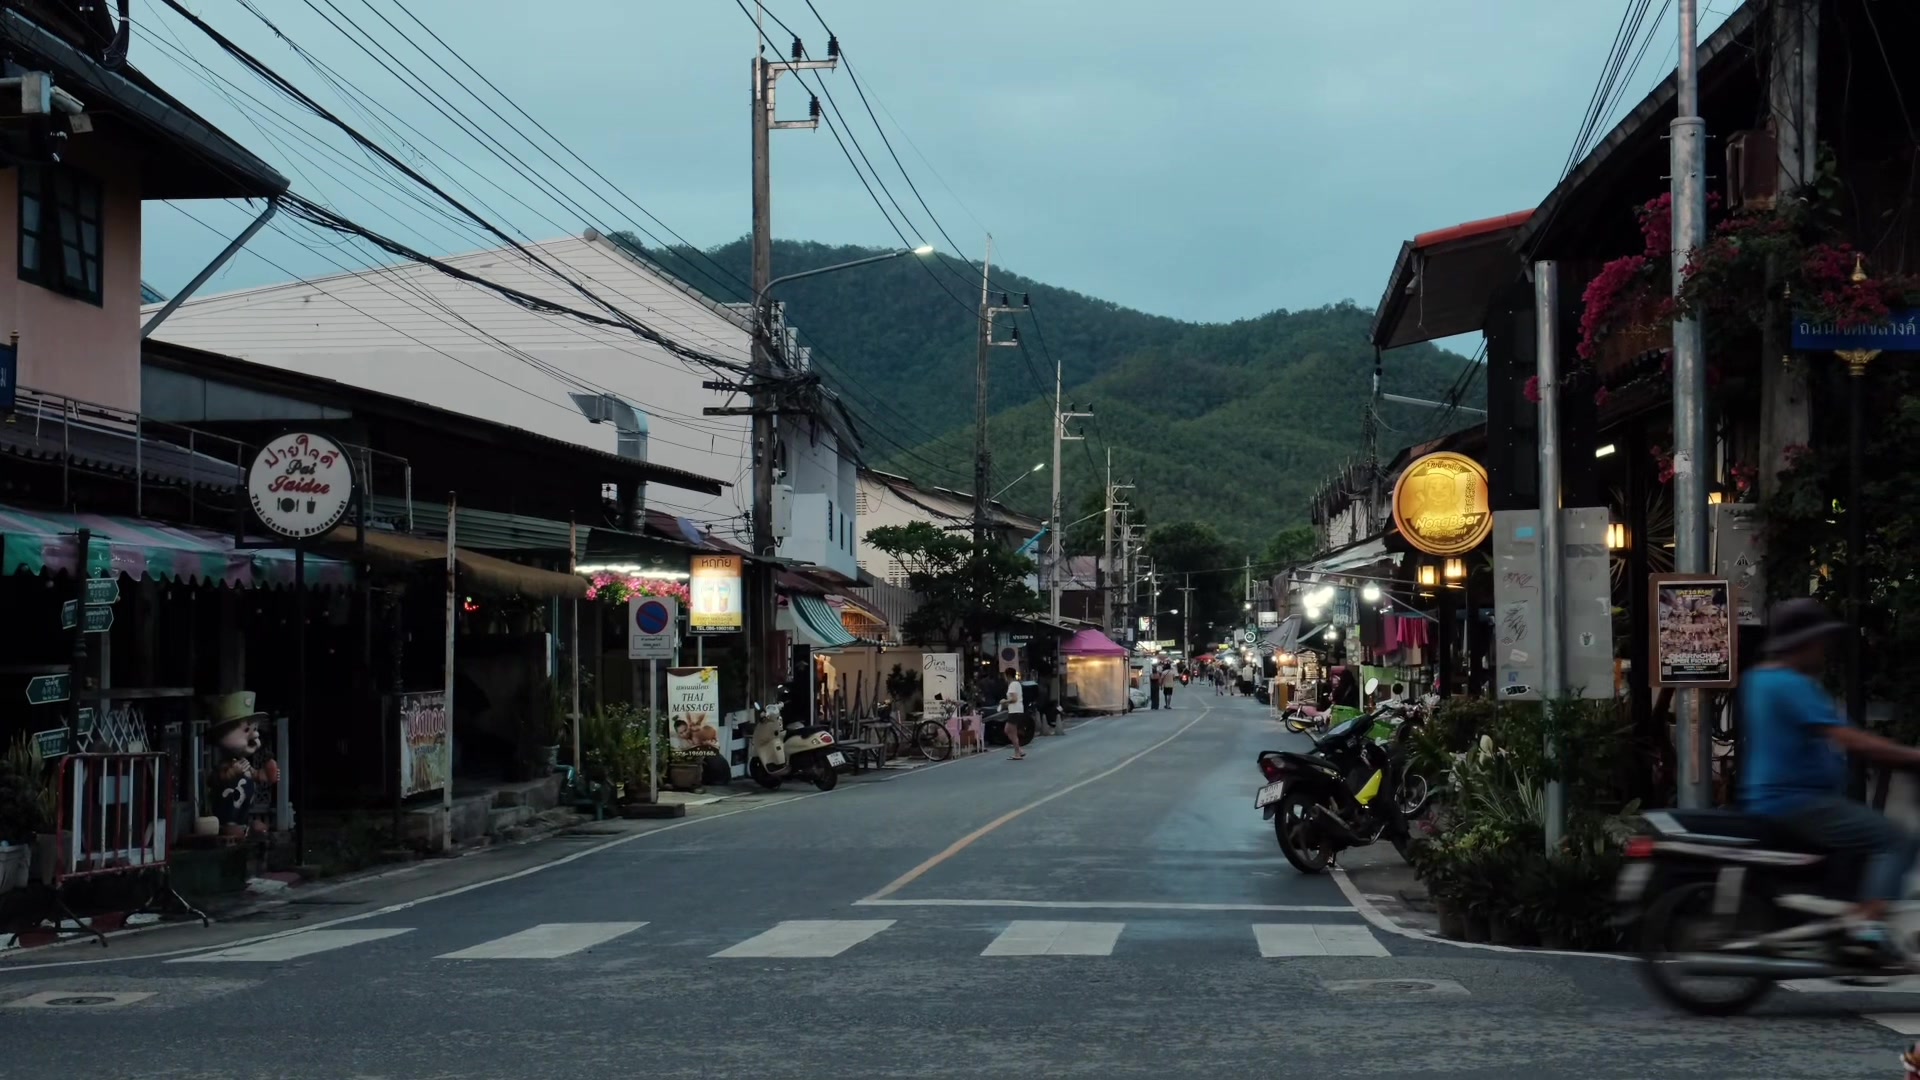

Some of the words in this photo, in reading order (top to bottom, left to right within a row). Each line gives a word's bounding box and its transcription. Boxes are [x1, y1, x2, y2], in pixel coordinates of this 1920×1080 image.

[264, 434, 339, 469] ปายใจดี
[286, 459, 317, 475] Pai
[268, 475, 331, 494] Jaidee
[304, 500, 347, 536] Restaurant
[682, 693, 704, 702] THAI
[672, 703, 715, 712] MASSAGE
